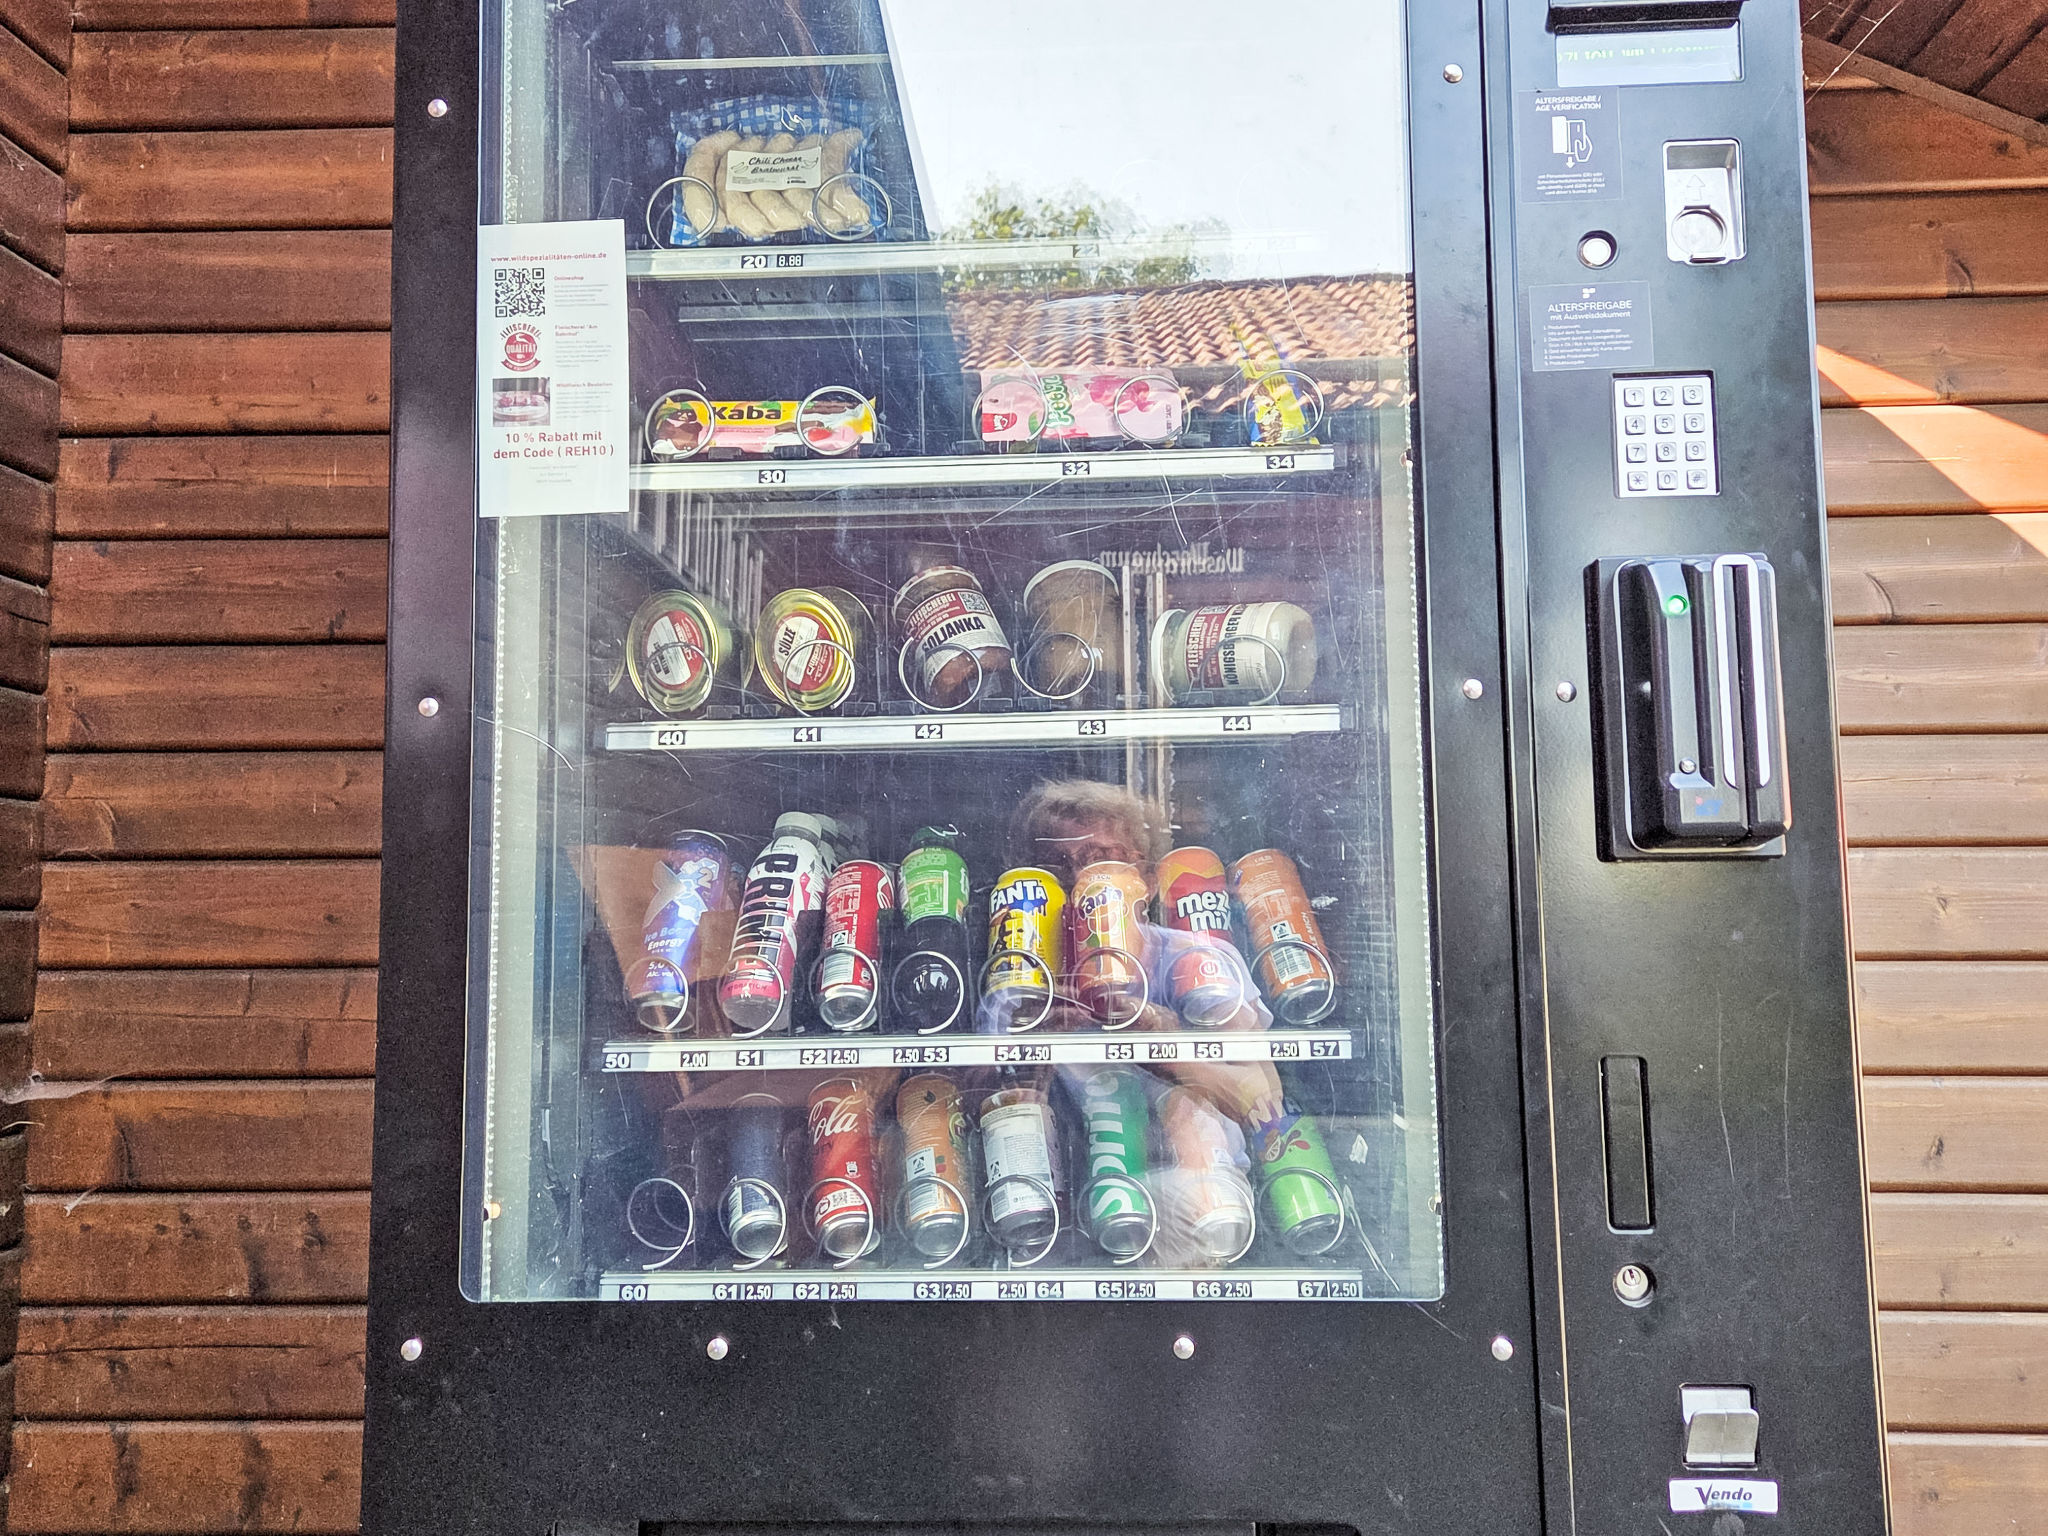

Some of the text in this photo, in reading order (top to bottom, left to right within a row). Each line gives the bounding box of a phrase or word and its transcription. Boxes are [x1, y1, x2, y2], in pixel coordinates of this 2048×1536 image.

[1535, 102, 1601, 112] AGE VERIFICATION
[748, 157, 771, 166] Chili
[750, 164, 800, 174] Bratwurst
[490, 252, 607, 262] www.wildspezialitäten-online.de
[1074, 245, 1099, 258] 22
[742, 255, 802, 269] 20 8.88
[1548, 299, 1633, 313] ALTERSFREIGABE
[1550, 311, 1632, 321] mit Ausweisdokument
[709, 405, 782, 421] Kaba
[505, 430, 602, 443] 10 % Rabatt mit
[493, 448, 520, 459] dem
[523, 447, 554, 458] Code
[565, 445, 606, 457] REH10
[1064, 463, 1090, 474] 32
[1268, 456, 1294, 468] 34
[759, 470, 785, 483] 30
[921, 615, 986, 652] SOLJANKA
[777, 626, 797, 657] SÜLZE
[1188, 616, 1206, 668] FLEISCHEREI
[1222, 616, 1241, 686] KÖNIGSBRGER
[917, 724, 942, 738] 42
[1080, 720, 1105, 734] 43
[1224, 716, 1251, 731] 44
[659, 731, 685, 745] 40
[795, 727, 820, 742] 41
[989, 879, 1049, 914] FANTA
[1189, 910, 1234, 932] mix
[647, 937, 688, 951] Energy
[801, 1049, 858, 1064] 52 2.50
[895, 1047, 949, 1063] 2.50 53
[997, 1045, 1050, 1061] 54 2.50
[1107, 1044, 1133, 1059] 55
[1151, 1043, 1222, 1058] 2.00 56
[1272, 1041, 1337, 1057] 2.50 57
[605, 1052, 708, 1068] 50 2.00
[738, 1052, 762, 1065] 51
[807, 1094, 860, 1146] Cola
[1082, 1073, 1138, 1219] Sprite
[621, 1284, 647, 1300] 60
[714, 1284, 772, 1300] 61 2.50
[795, 1284, 856, 1299] 62 2.50
[916, 1283, 971, 1299] 63 2.50
[1000, 1283, 1063, 1298] 2.50 64
[1098, 1282, 1154, 1298] 65 2.50
[1196, 1282, 1251, 1297] 66 2.50
[1300, 1282, 1358, 1297] 67 2.50
[1694, 1484, 1753, 1506] Vendo
